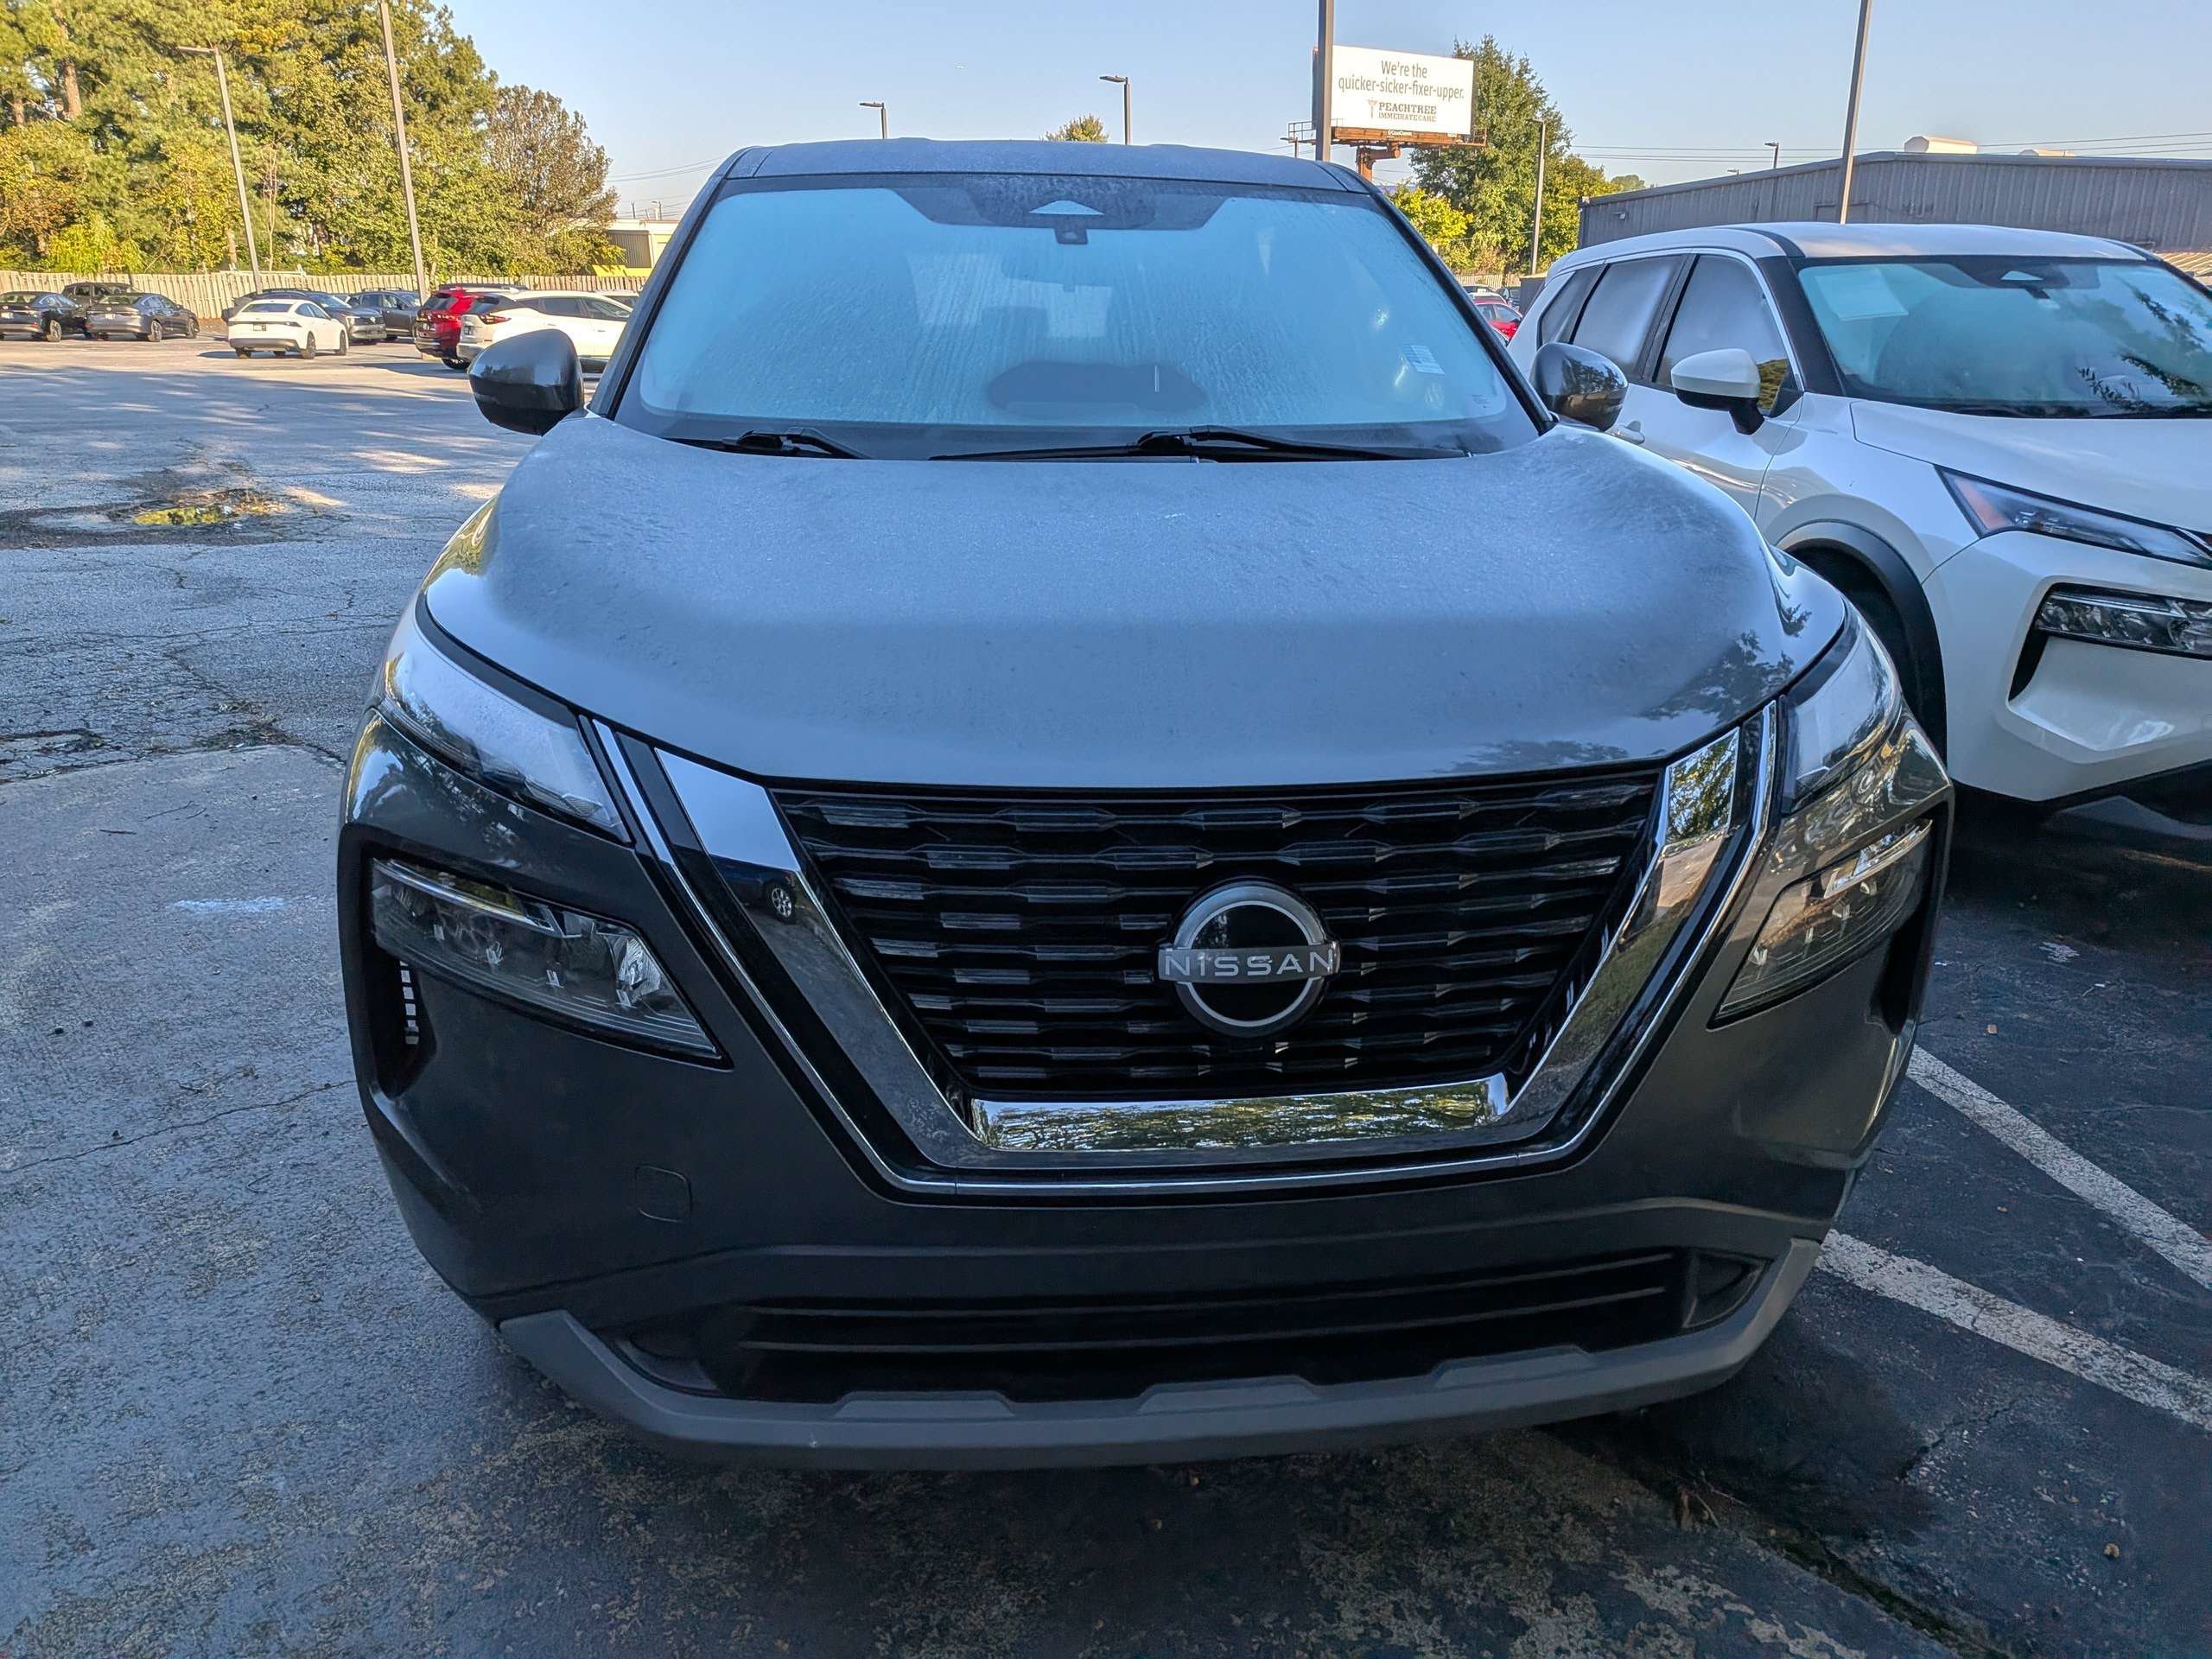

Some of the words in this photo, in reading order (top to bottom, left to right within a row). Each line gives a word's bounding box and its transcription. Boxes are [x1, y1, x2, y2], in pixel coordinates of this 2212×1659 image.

[1381, 60, 1409, 77] We're
[1412, 63, 1427, 79] the
[1338, 73, 1465, 101] quicker-sicker-fixer-upper.
[1378, 102, 1437, 114] PEACHTREE
[1166, 951, 1334, 976] NISSAN
